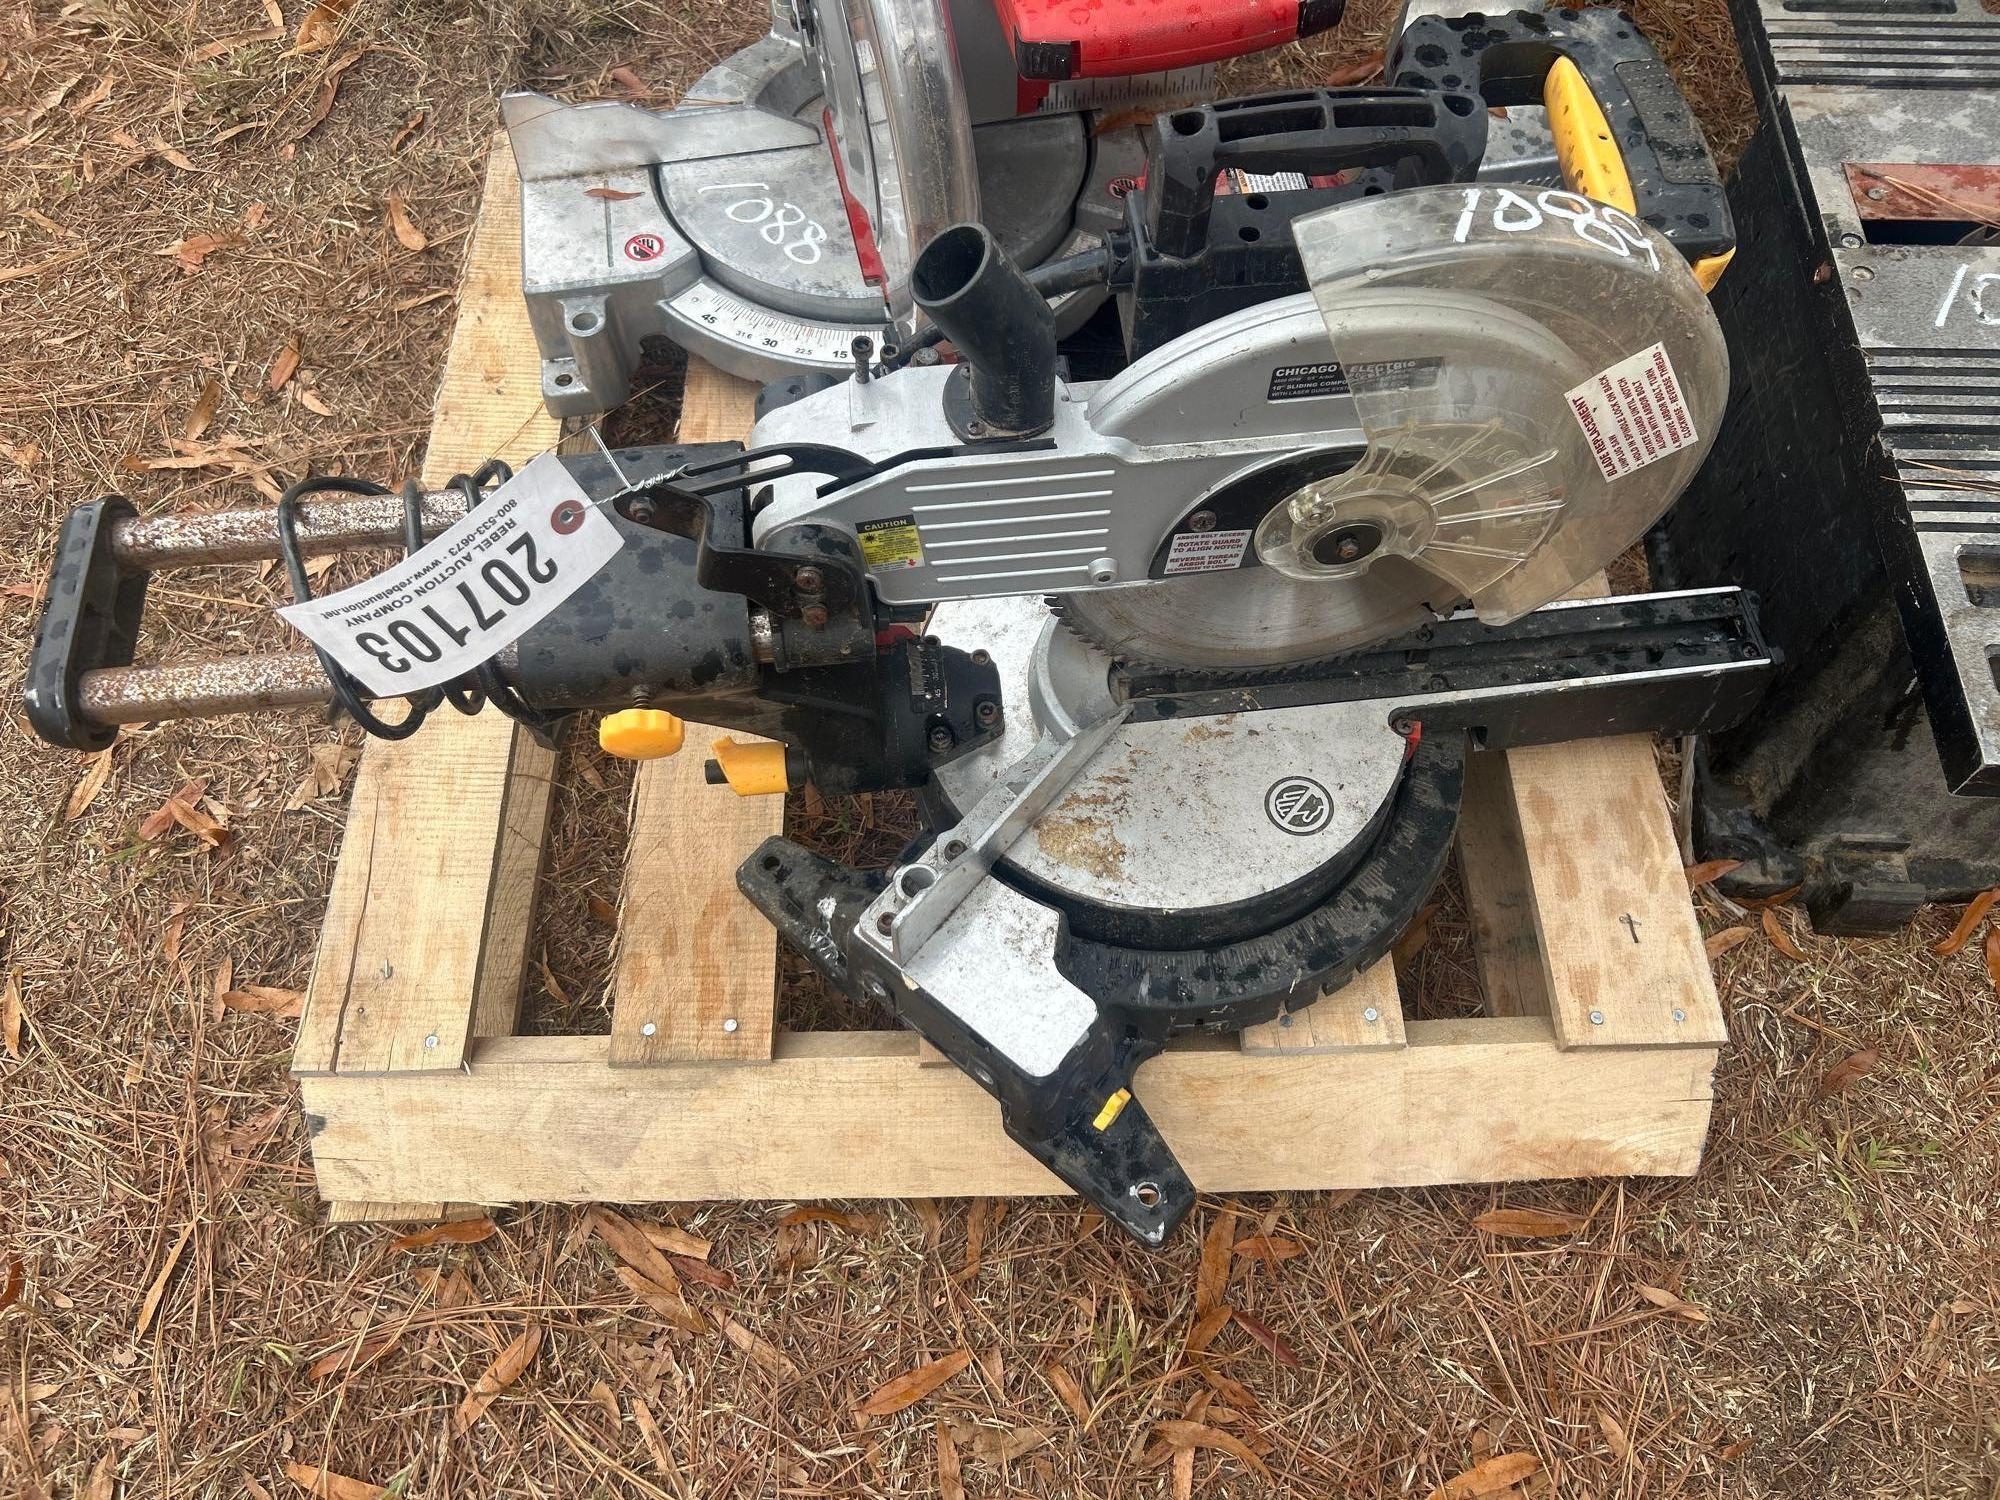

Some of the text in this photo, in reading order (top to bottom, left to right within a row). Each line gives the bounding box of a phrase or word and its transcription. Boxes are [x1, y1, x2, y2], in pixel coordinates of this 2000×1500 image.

[697, 183, 827, 264] 1088
[1453, 188, 1660, 271] 1089
[701, 313, 718, 324] 45
[735, 329, 753, 340] 31.6
[762, 337, 778, 348] 30
[794, 346, 813, 356] 22.5
[832, 350, 848, 359] 15
[1276, 365, 1338, 377] CHICAGO
[1653, 351, 1668, 376] THREAD
[1286, 382, 1318, 390] SLIDING
[1599, 375, 1611, 391] BACK
[1645, 368, 1657, 385] TURN
[1606, 391, 1616, 402] ON
[1617, 377, 1631, 398] NOTCH
[1662, 376, 1677, 403] REVERSE
[1611, 401, 1622, 417] LOCK
[1627, 398, 1638, 415] UNTIL
[1632, 379, 1665, 449] ALIGNS WITH ARBOR BOLT
[1658, 401, 1671, 421] ARBOR
[1618, 417, 1632, 440] SPINDLE
[1634, 415, 1647, 435] GUARD
[1666, 420, 1680, 443] REMOVE
[1674, 406, 1691, 438] CLOCKWISE
[1573, 395, 1617, 476] BLADE REPLACEMENT
[1609, 434, 1618, 447] SAW
[1627, 439, 1636, 447] IN
[1642, 435, 1655, 455] ROTATE
[1614, 446, 1628, 467] UNPLUG
[1630, 446, 1642, 461] HOLD
[864, 519, 907, 531] CAUTION
[320, 499, 517, 619] 800-533-0673 www.rebelauction.net
[345, 518, 517, 627] REBEL AUCTION COMPANY
[355, 531, 558, 673] 207103
